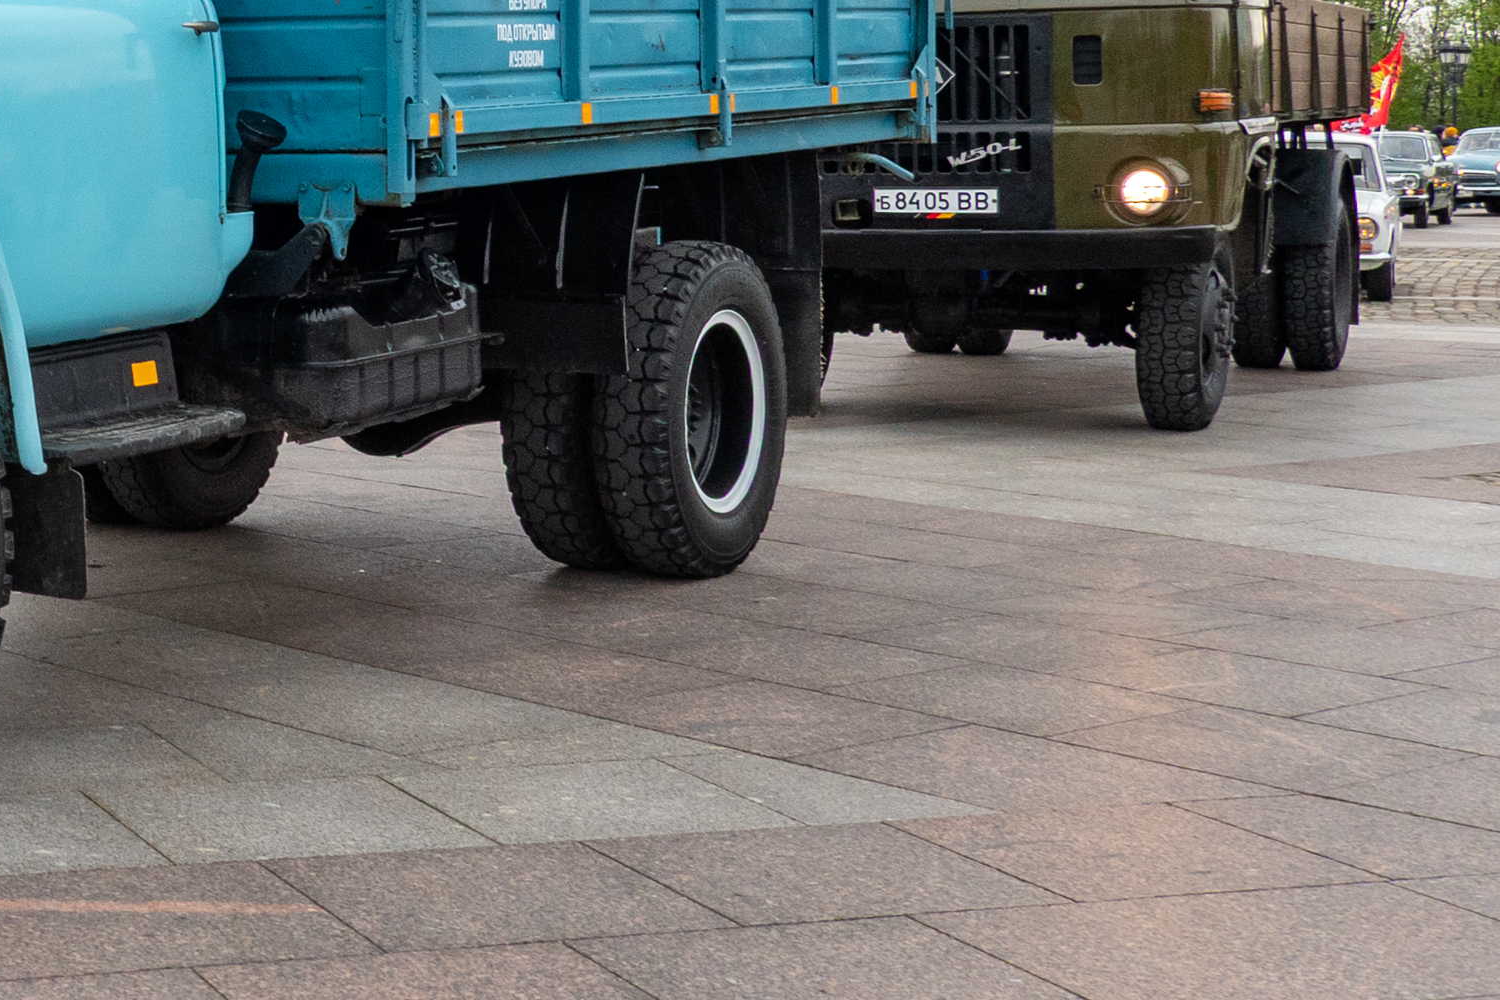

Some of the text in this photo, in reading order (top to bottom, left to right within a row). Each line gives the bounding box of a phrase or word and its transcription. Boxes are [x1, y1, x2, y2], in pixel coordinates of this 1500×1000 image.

[496, 23, 556, 43] ПОД ОТКРЫТЫМ
[508, 49, 545, 68] КУЗОВОМ
